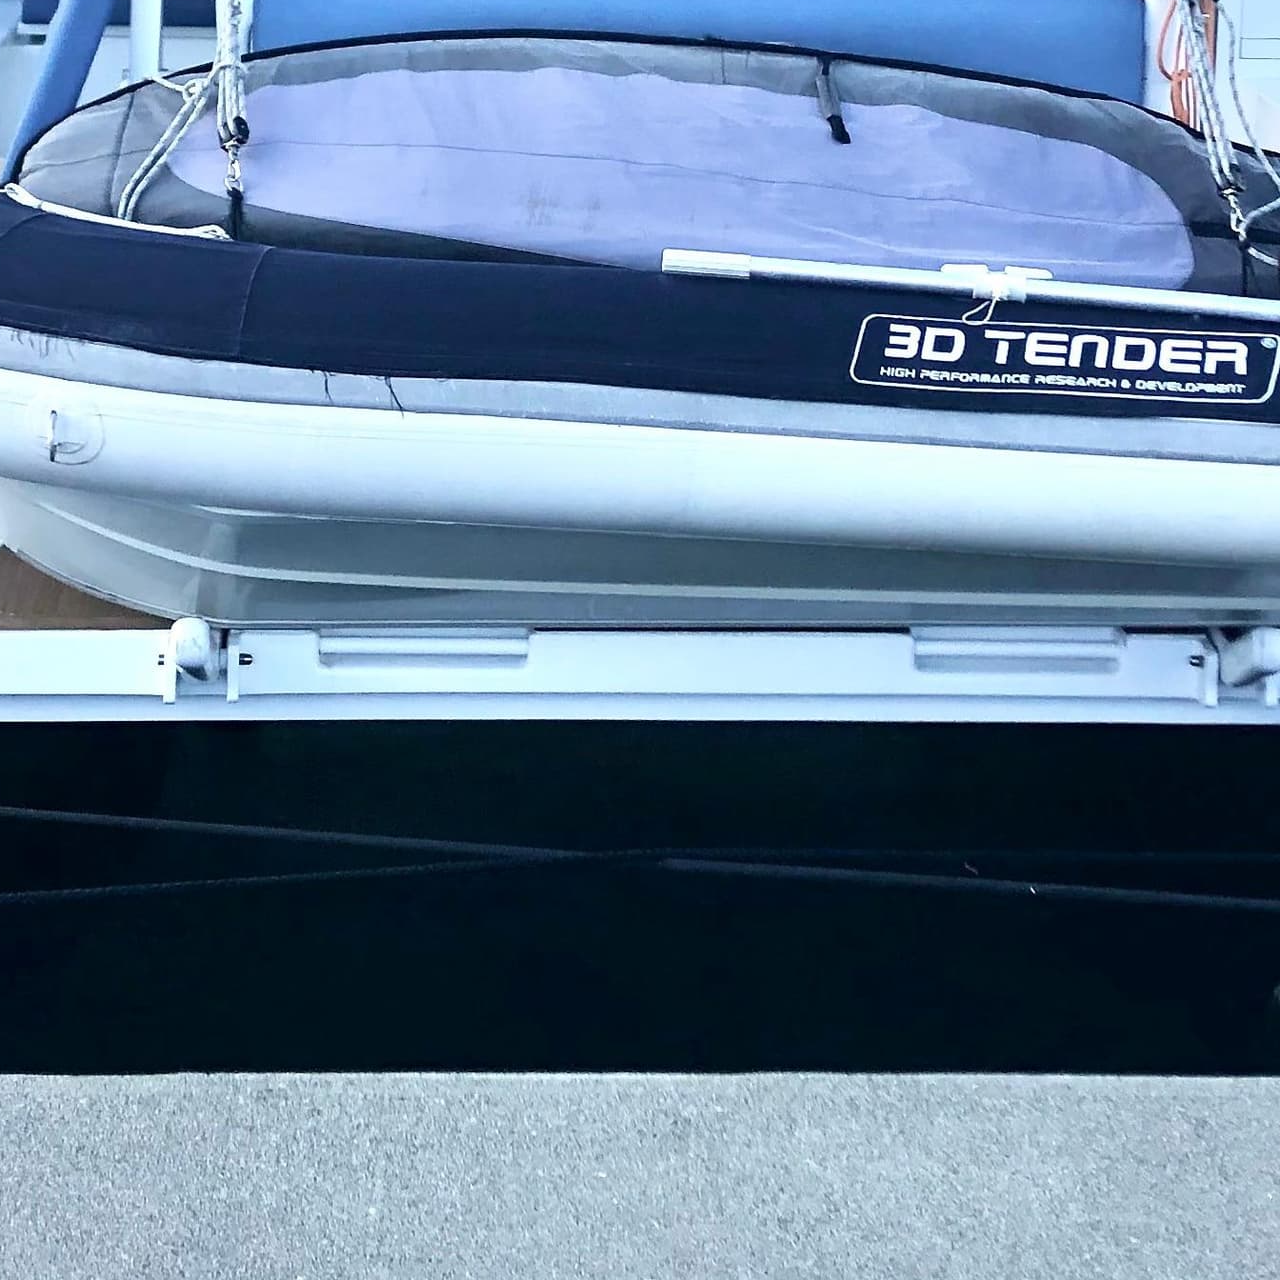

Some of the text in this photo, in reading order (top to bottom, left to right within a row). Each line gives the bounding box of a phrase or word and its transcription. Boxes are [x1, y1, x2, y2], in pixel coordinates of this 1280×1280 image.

[884, 323, 1249, 376] 3D TENDER
[879, 366, 1247, 394] HIGH PERFORMANCE RESEARCH & DEVELOPMENT
